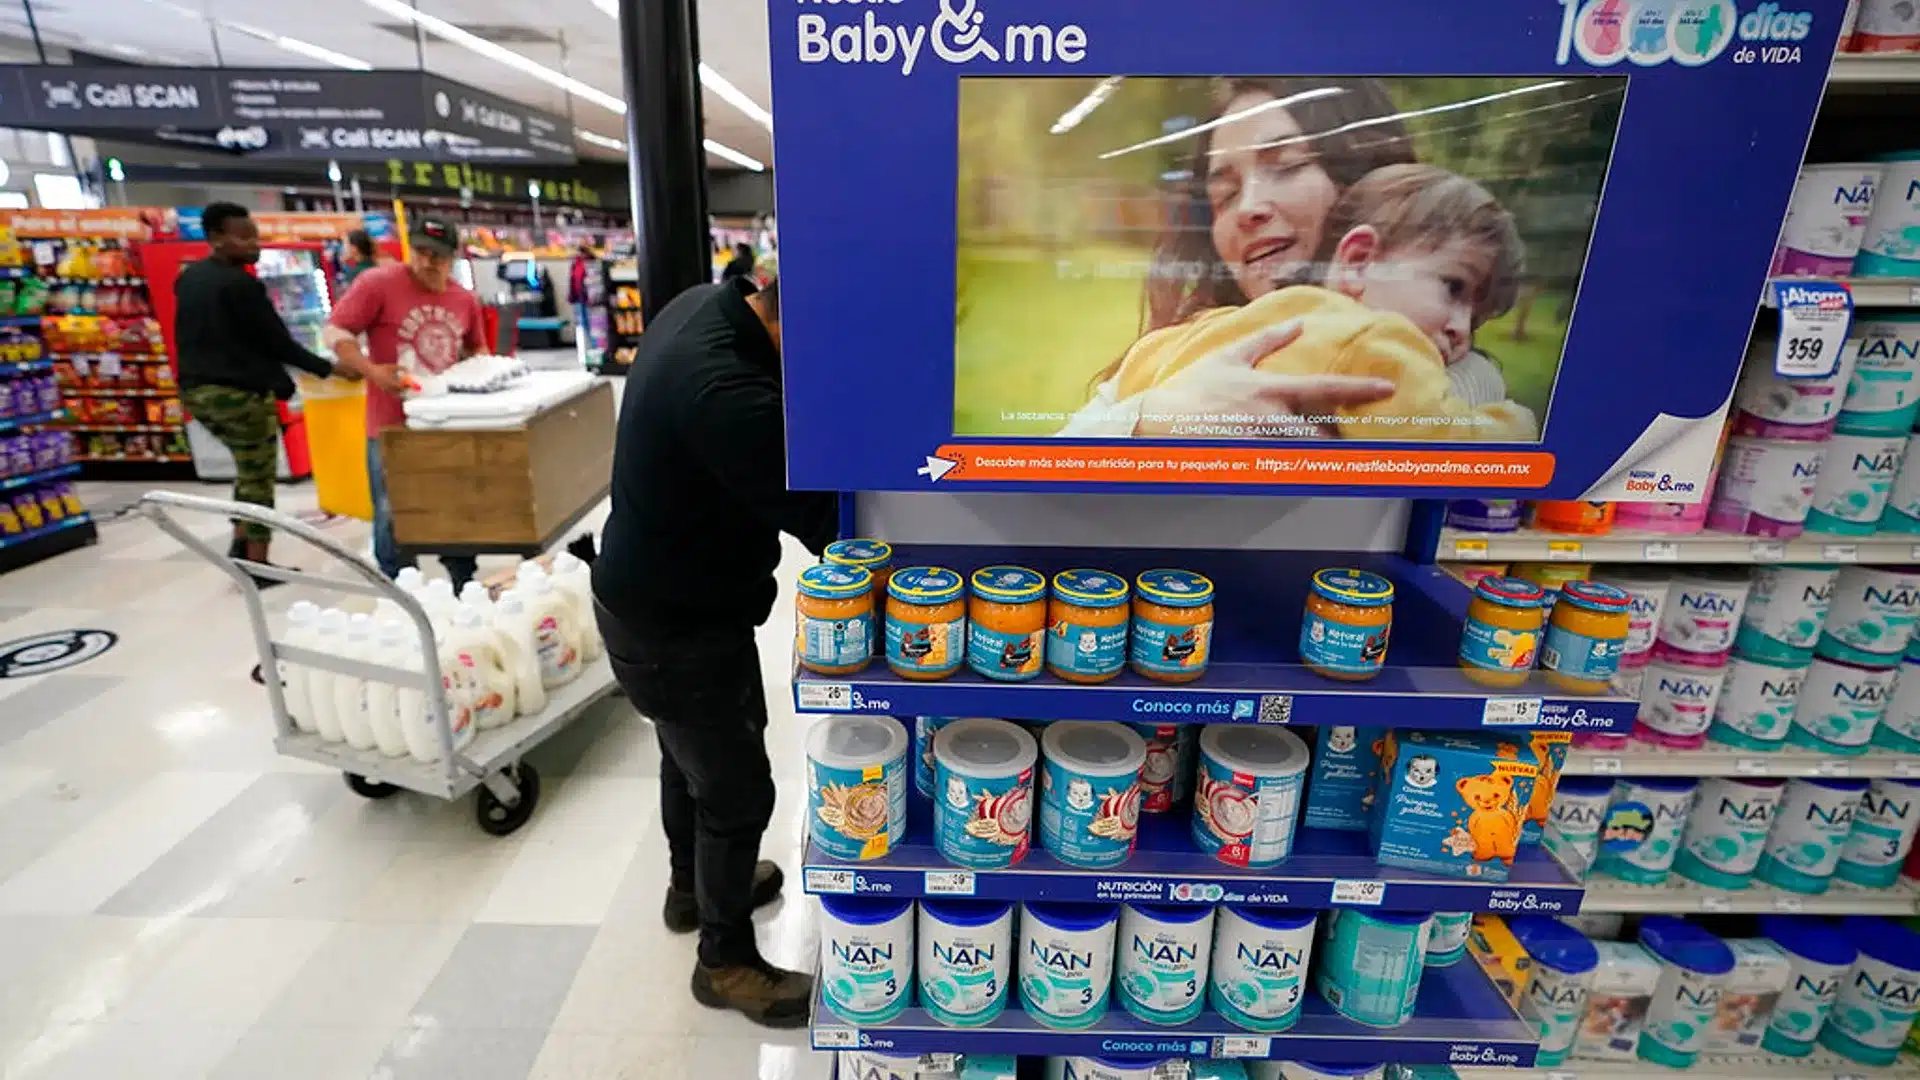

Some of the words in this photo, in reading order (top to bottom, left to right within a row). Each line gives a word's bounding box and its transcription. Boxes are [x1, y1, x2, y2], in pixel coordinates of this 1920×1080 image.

[1738, 2, 1813, 41] días
[798, 11, 926, 75] Baby
[1005, 24, 1087, 63] me
[1733, 49, 1755, 64] de
[1760, 47, 1802, 64] VIDA
[133, 84, 199, 108] SCAN
[370, 127, 421, 149] SCAN
[1834, 187, 1874, 204] NA
[1786, 337, 1824, 360] 359
[975, 456, 1027, 468] Descubre
[1029, 457, 1052, 468] más
[1055, 458, 1085, 469] sobre
[1087, 458, 1136, 469] nutrición
[1138, 460, 1164, 472] para
[1167, 459, 1178, 469] tu
[1180, 459, 1230, 473] pequeño
[1852, 453, 1894, 471] NA
[1626, 480, 1657, 494] Baby
[1674, 482, 1694, 491] me
[1631, 598, 1657, 612] AN
[1680, 592, 1735, 612] NAN
[1660, 679, 1713, 696] NAN
[1761, 681, 1797, 696] NA
[868, 699, 890, 709] me
[1132, 698, 1192, 713] Conoce
[1196, 700, 1230, 714] más
[1590, 716, 1614, 727] me
[1719, 797, 1767, 820] NA
[1806, 803, 1851, 824] NA
[1860, 791, 1910, 819] AN
[871, 882, 892, 892] me
[1097, 880, 1163, 893] NUTRICIÓN
[1247, 893, 1261, 902] de
[1263, 894, 1289, 903] VIDA
[1488, 899, 1522, 911] Baby
[1540, 902, 1561, 911] me
[832, 939, 892, 964] NAN
[934, 940, 995, 965] NAN
[1031, 937, 1092, 970] NAN
[1133, 934, 1197, 963] NAN
[1238, 942, 1303, 969] NAN
[884, 978, 896, 996] 3
[985, 979, 996, 998] 3
[1185, 978, 1196, 997] 3
[1288, 984, 1299, 1003] 3
[1531, 980, 1586, 1003] NA
[1795, 974, 1838, 995] NA
[1081, 987, 1093, 1005] 3
[1676, 985, 1718, 1004] NA
[874, 1039, 894, 1048] me
[1102, 1039, 1153, 1052] Conoce
[1156, 1039, 1186, 1052] más
[1449, 1052, 1480, 1063] Baby
[1498, 1054, 1518, 1063] me
